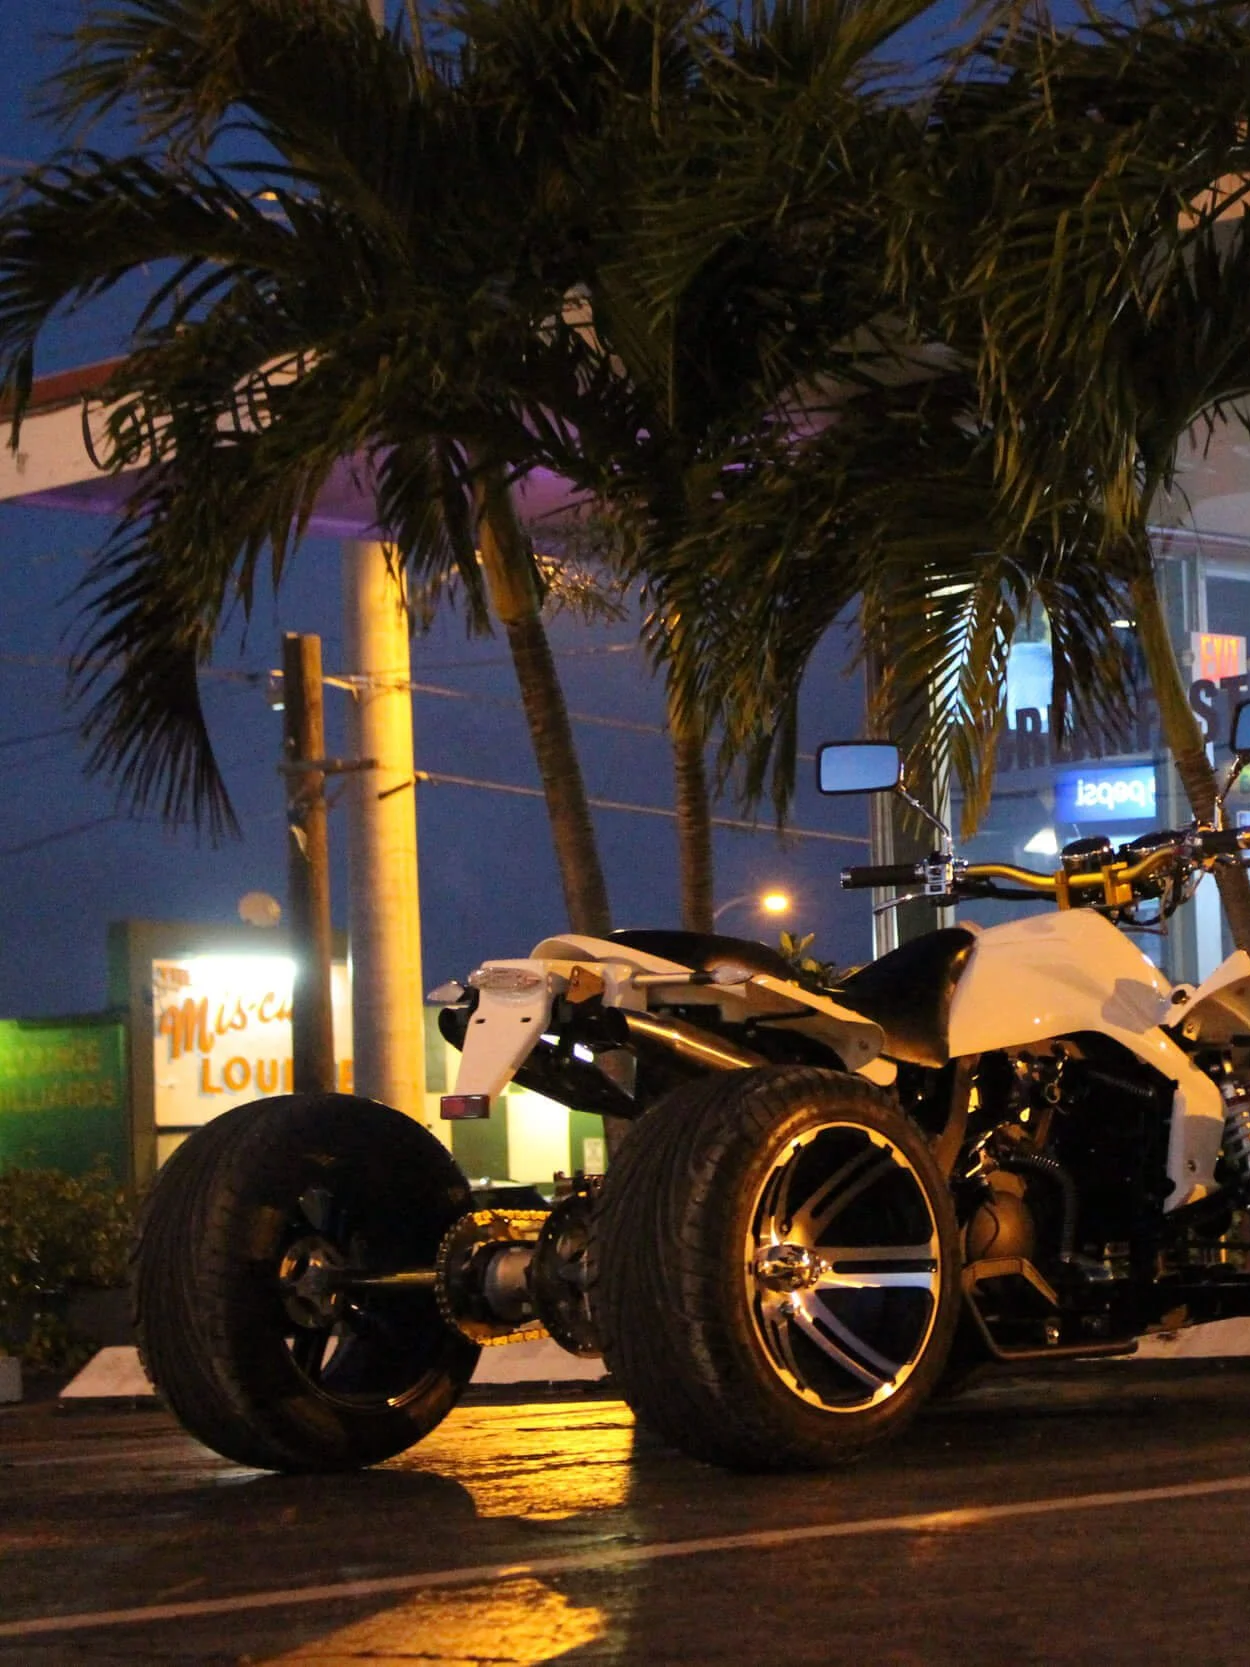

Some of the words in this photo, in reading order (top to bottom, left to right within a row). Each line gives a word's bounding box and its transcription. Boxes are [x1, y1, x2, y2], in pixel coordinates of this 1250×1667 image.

[1200, 635, 1239, 679] EXIT
[159, 991, 293, 1060] Mis-Cu
[202, 1055, 354, 1095] LOUE
